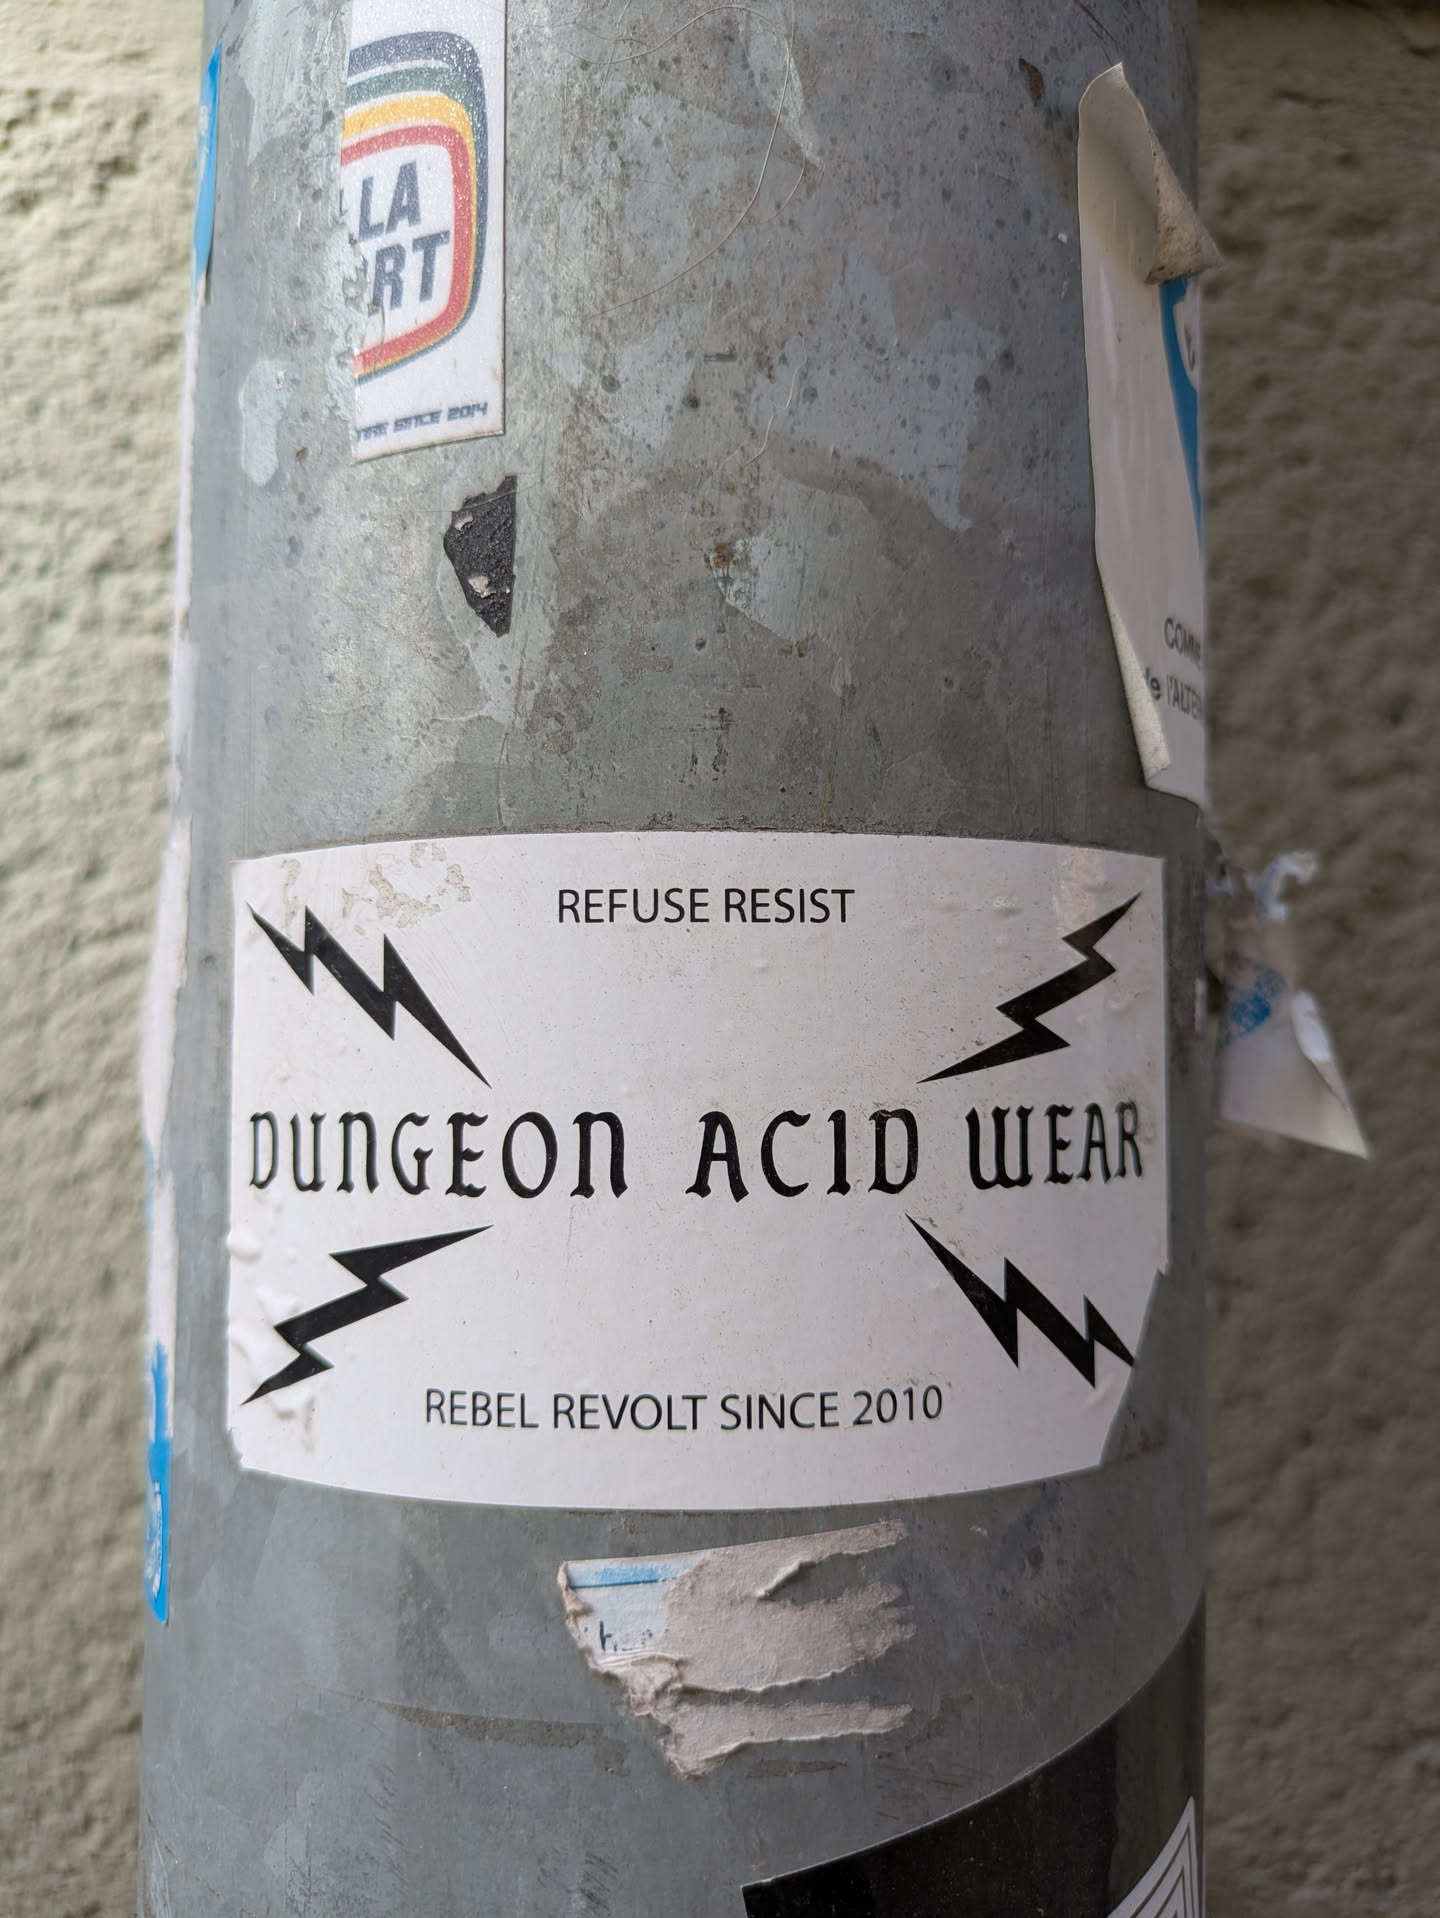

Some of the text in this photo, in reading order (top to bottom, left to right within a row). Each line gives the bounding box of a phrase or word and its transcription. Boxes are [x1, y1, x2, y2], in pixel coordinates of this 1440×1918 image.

[340, 161, 422, 241] LA
[350, 230, 450, 316] RT
[446, 402, 488, 421] 2014
[558, 888, 856, 924] REFUSE RESIST
[249, 1096, 1146, 1203] DUNGEON ACID WEAR
[426, 1384, 943, 1431] REBEL REVOLT SINCE 2010
